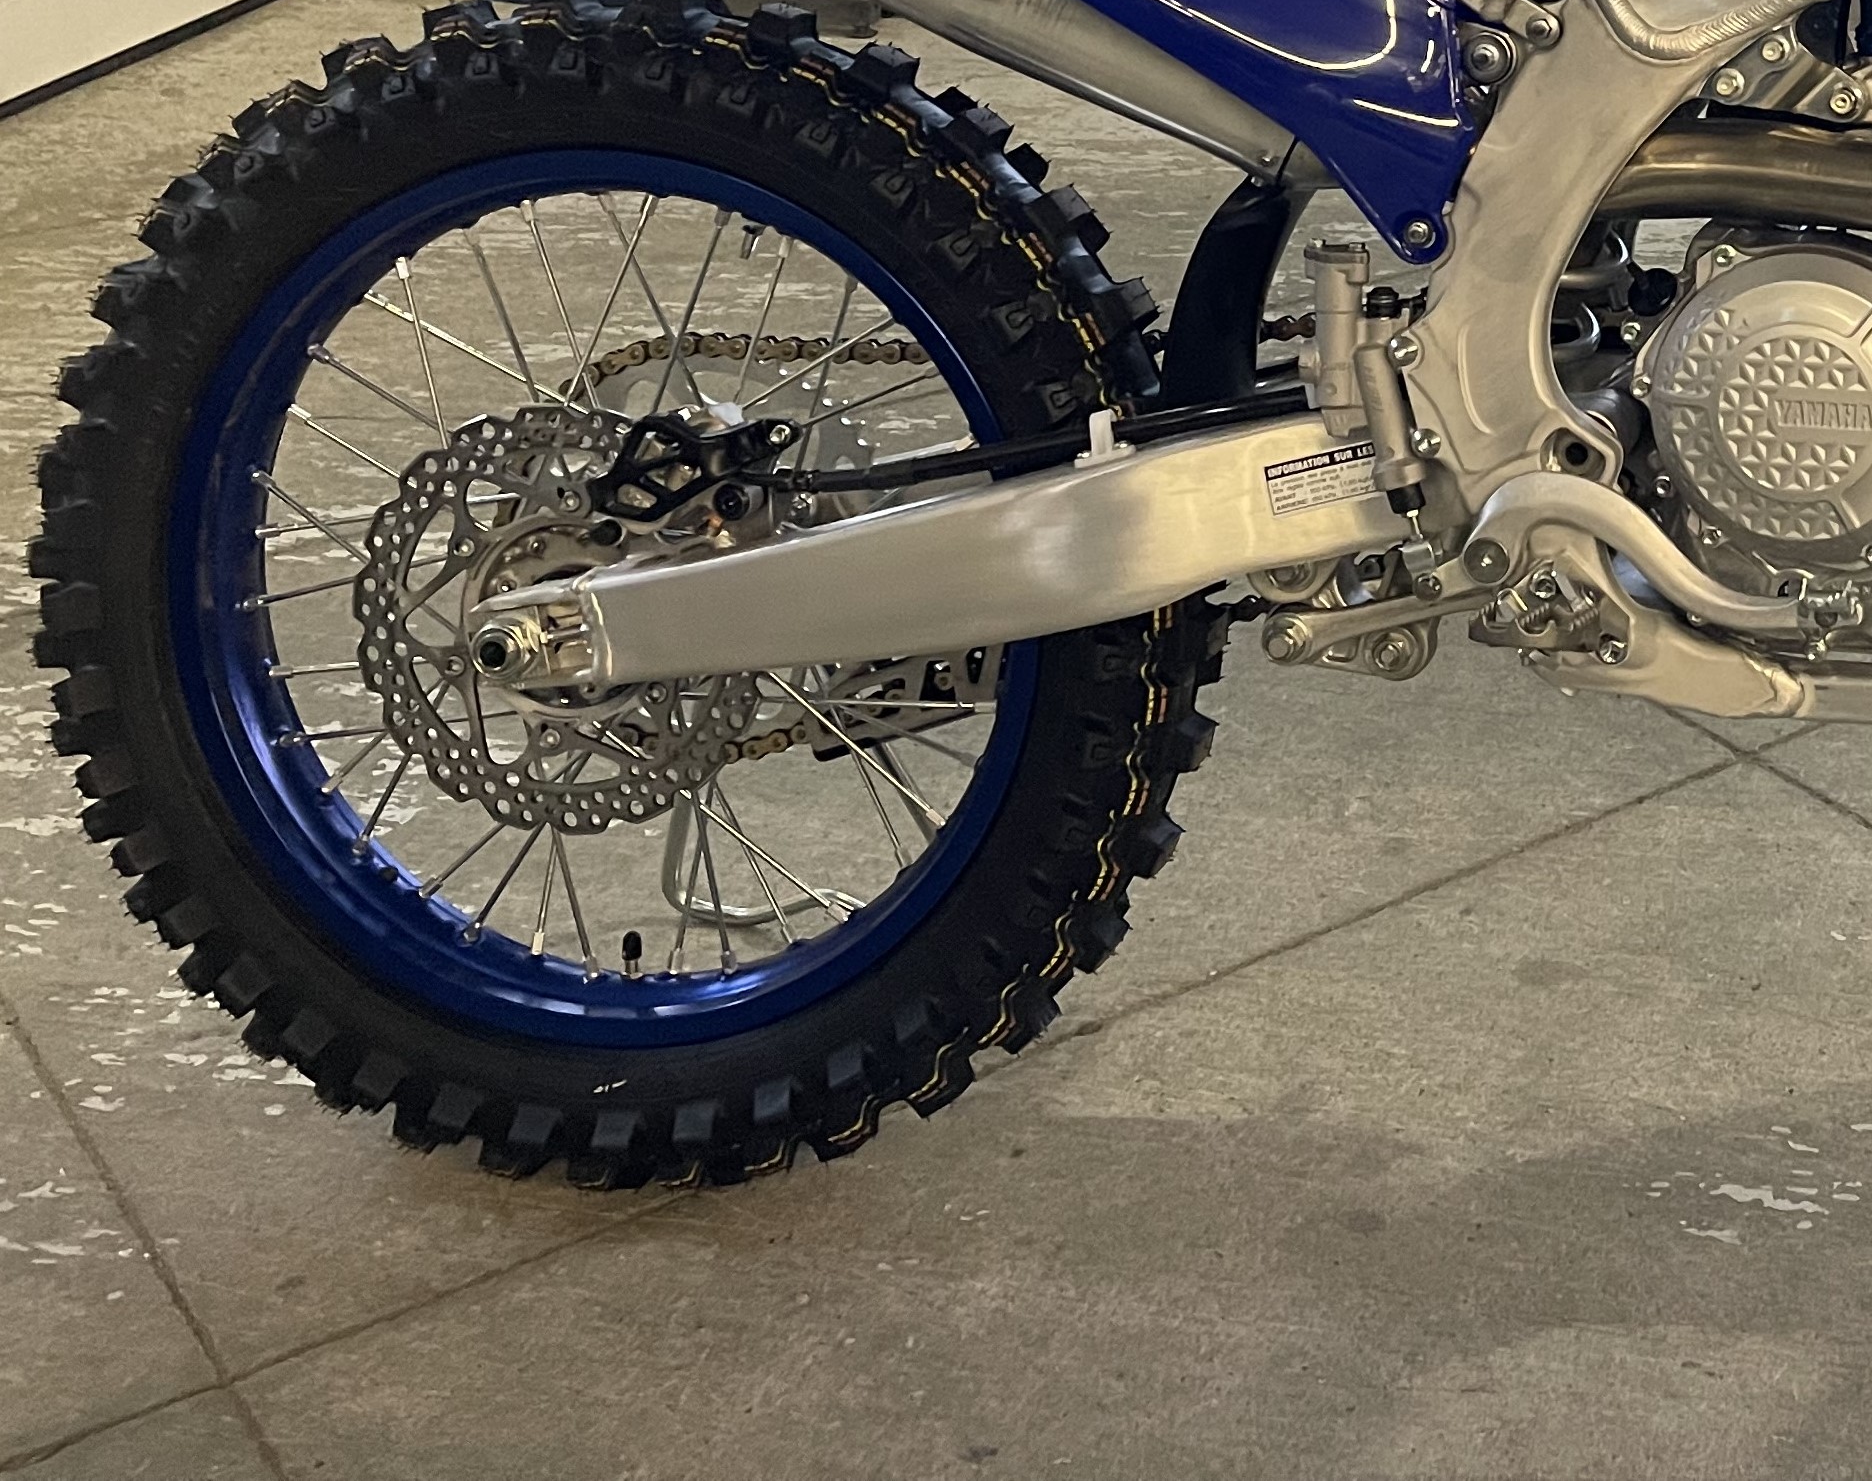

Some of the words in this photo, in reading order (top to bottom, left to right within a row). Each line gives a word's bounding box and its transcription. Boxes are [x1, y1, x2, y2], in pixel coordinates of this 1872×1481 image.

[1774, 399, 1872, 432] YAMAHA
[1267, 455, 1330, 478] INFORMATION
[1333, 449, 1353, 462] SUR
